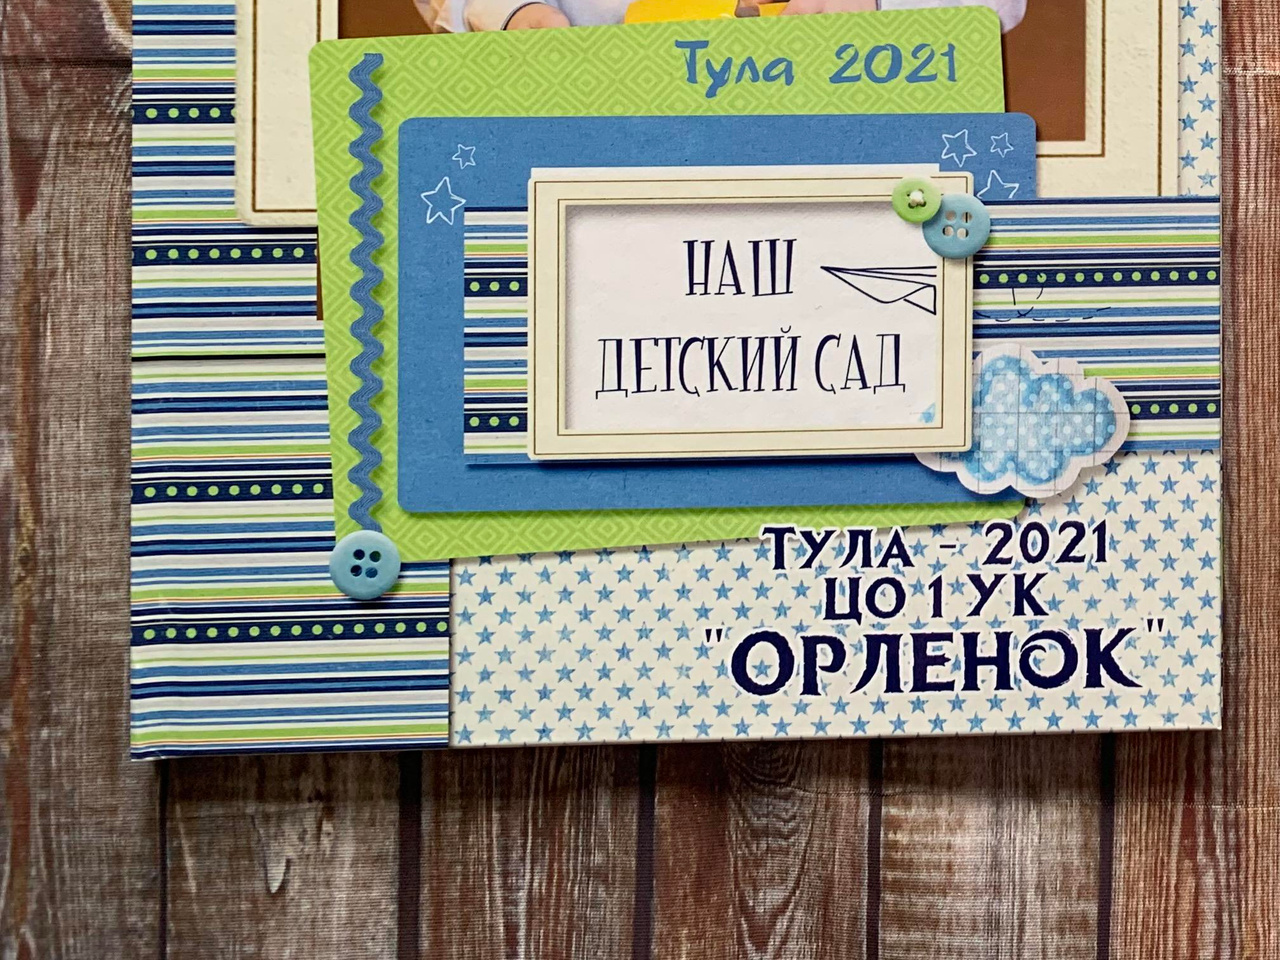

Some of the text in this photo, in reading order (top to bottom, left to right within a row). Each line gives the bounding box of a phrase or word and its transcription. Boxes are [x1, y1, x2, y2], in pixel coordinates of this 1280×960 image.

[675, 39, 959, 98] Тула 2021
[683, 238, 798, 296] НАШ
[595, 325, 906, 400] ДЕТСКИЙ САД
[761, 526, 915, 571] ТУЛА
[983, 519, 1110, 565] 2021
[824, 572, 1048, 624] ЦО 1 УК
[704, 618, 1167, 698] "ОРЛЕНОК"
